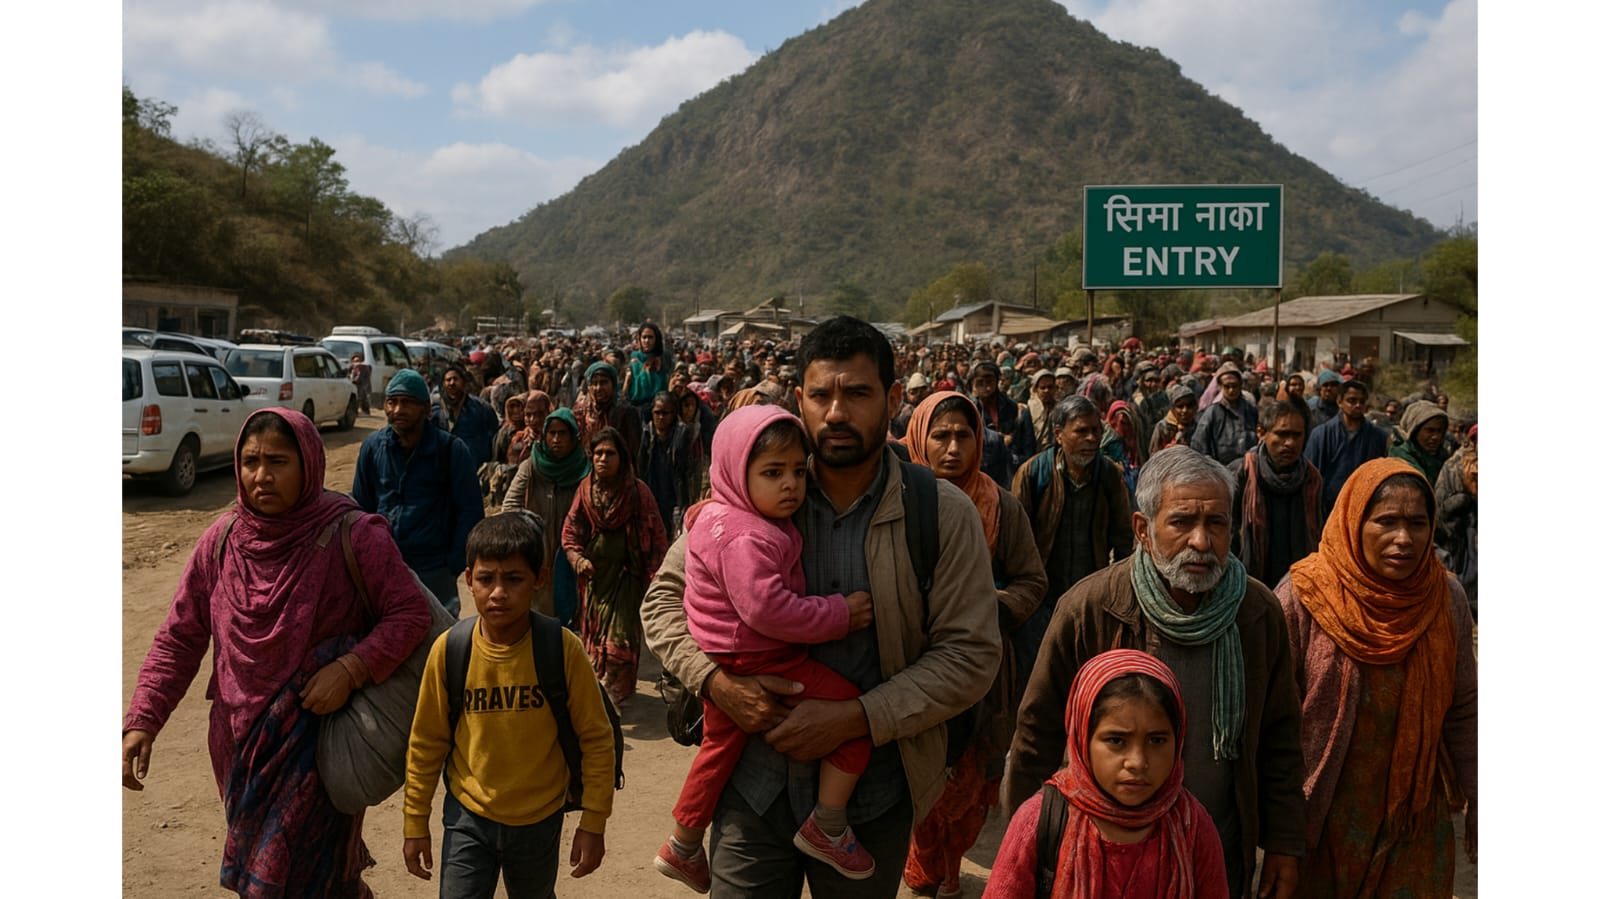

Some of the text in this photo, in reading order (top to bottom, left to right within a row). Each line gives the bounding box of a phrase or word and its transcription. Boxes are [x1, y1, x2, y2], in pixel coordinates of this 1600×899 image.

[1103, 194, 1270, 233] सिमा नाका
[1123, 246, 1240, 276] ENTRY
